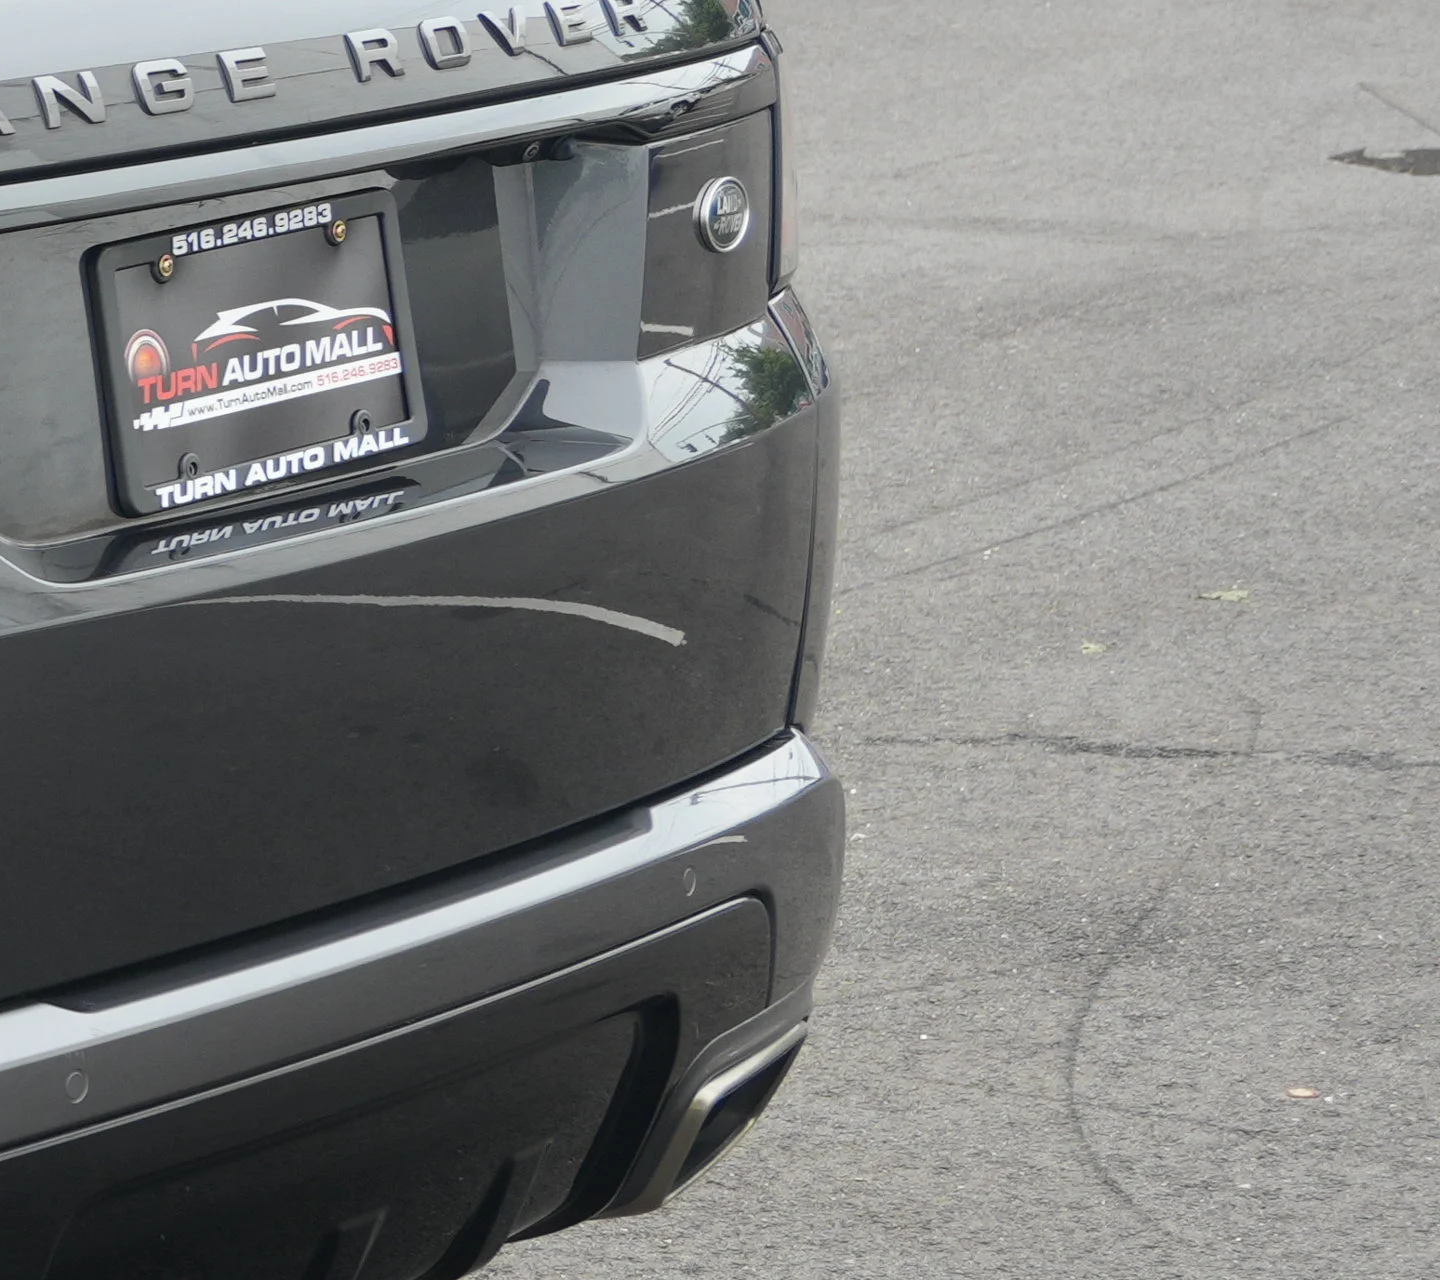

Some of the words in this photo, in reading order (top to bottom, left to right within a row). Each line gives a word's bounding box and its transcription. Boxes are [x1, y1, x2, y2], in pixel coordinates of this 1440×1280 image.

[171, 202, 332, 256] 516.246.9283
[716, 194, 739, 216] LAND
[716, 212, 743, 236] ROVER
[137, 363, 218, 404] TURN
[222, 343, 301, 386] AUTO
[305, 326, 383, 368] MALL
[187, 380, 313, 417] www.TurnAutoMall.com
[316, 358, 399, 387] 516.246.9283
[155, 469, 237, 508] TURN
[244, 446, 325, 487] AUTO
[333, 428, 410, 463] MALL
